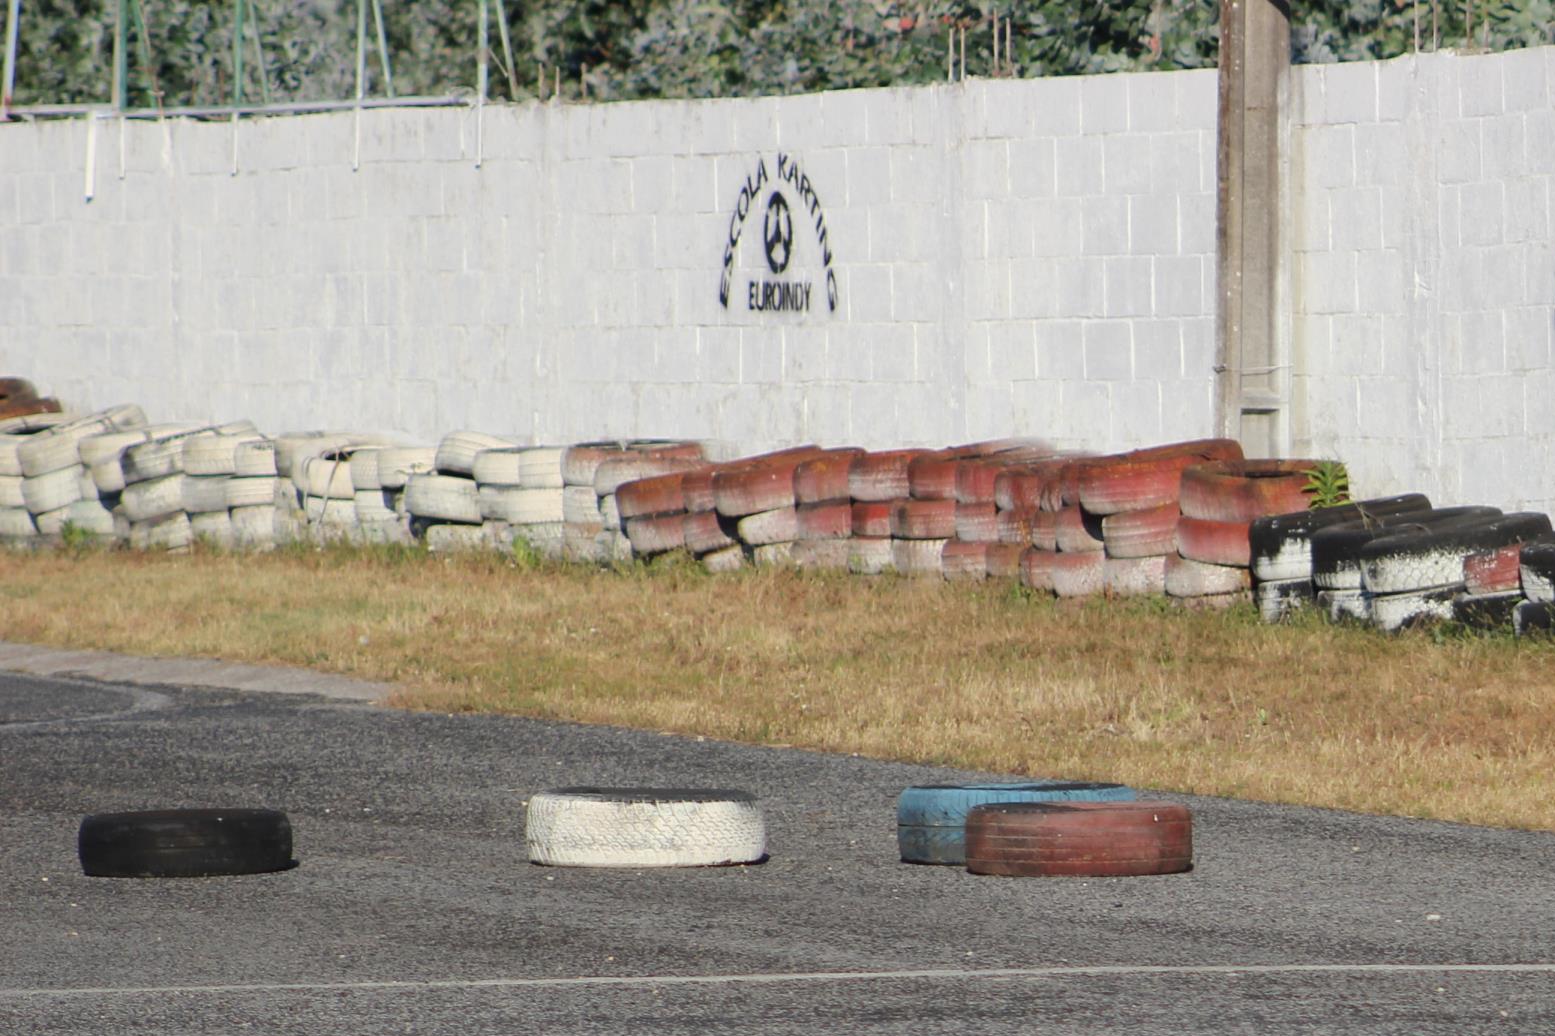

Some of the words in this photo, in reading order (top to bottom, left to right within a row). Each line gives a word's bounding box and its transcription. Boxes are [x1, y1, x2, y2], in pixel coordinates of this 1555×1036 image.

[720, 157, 768, 310] ESCOLA
[778, 152, 839, 312] KARTING
[748, 280, 812, 311] EUROINDY
